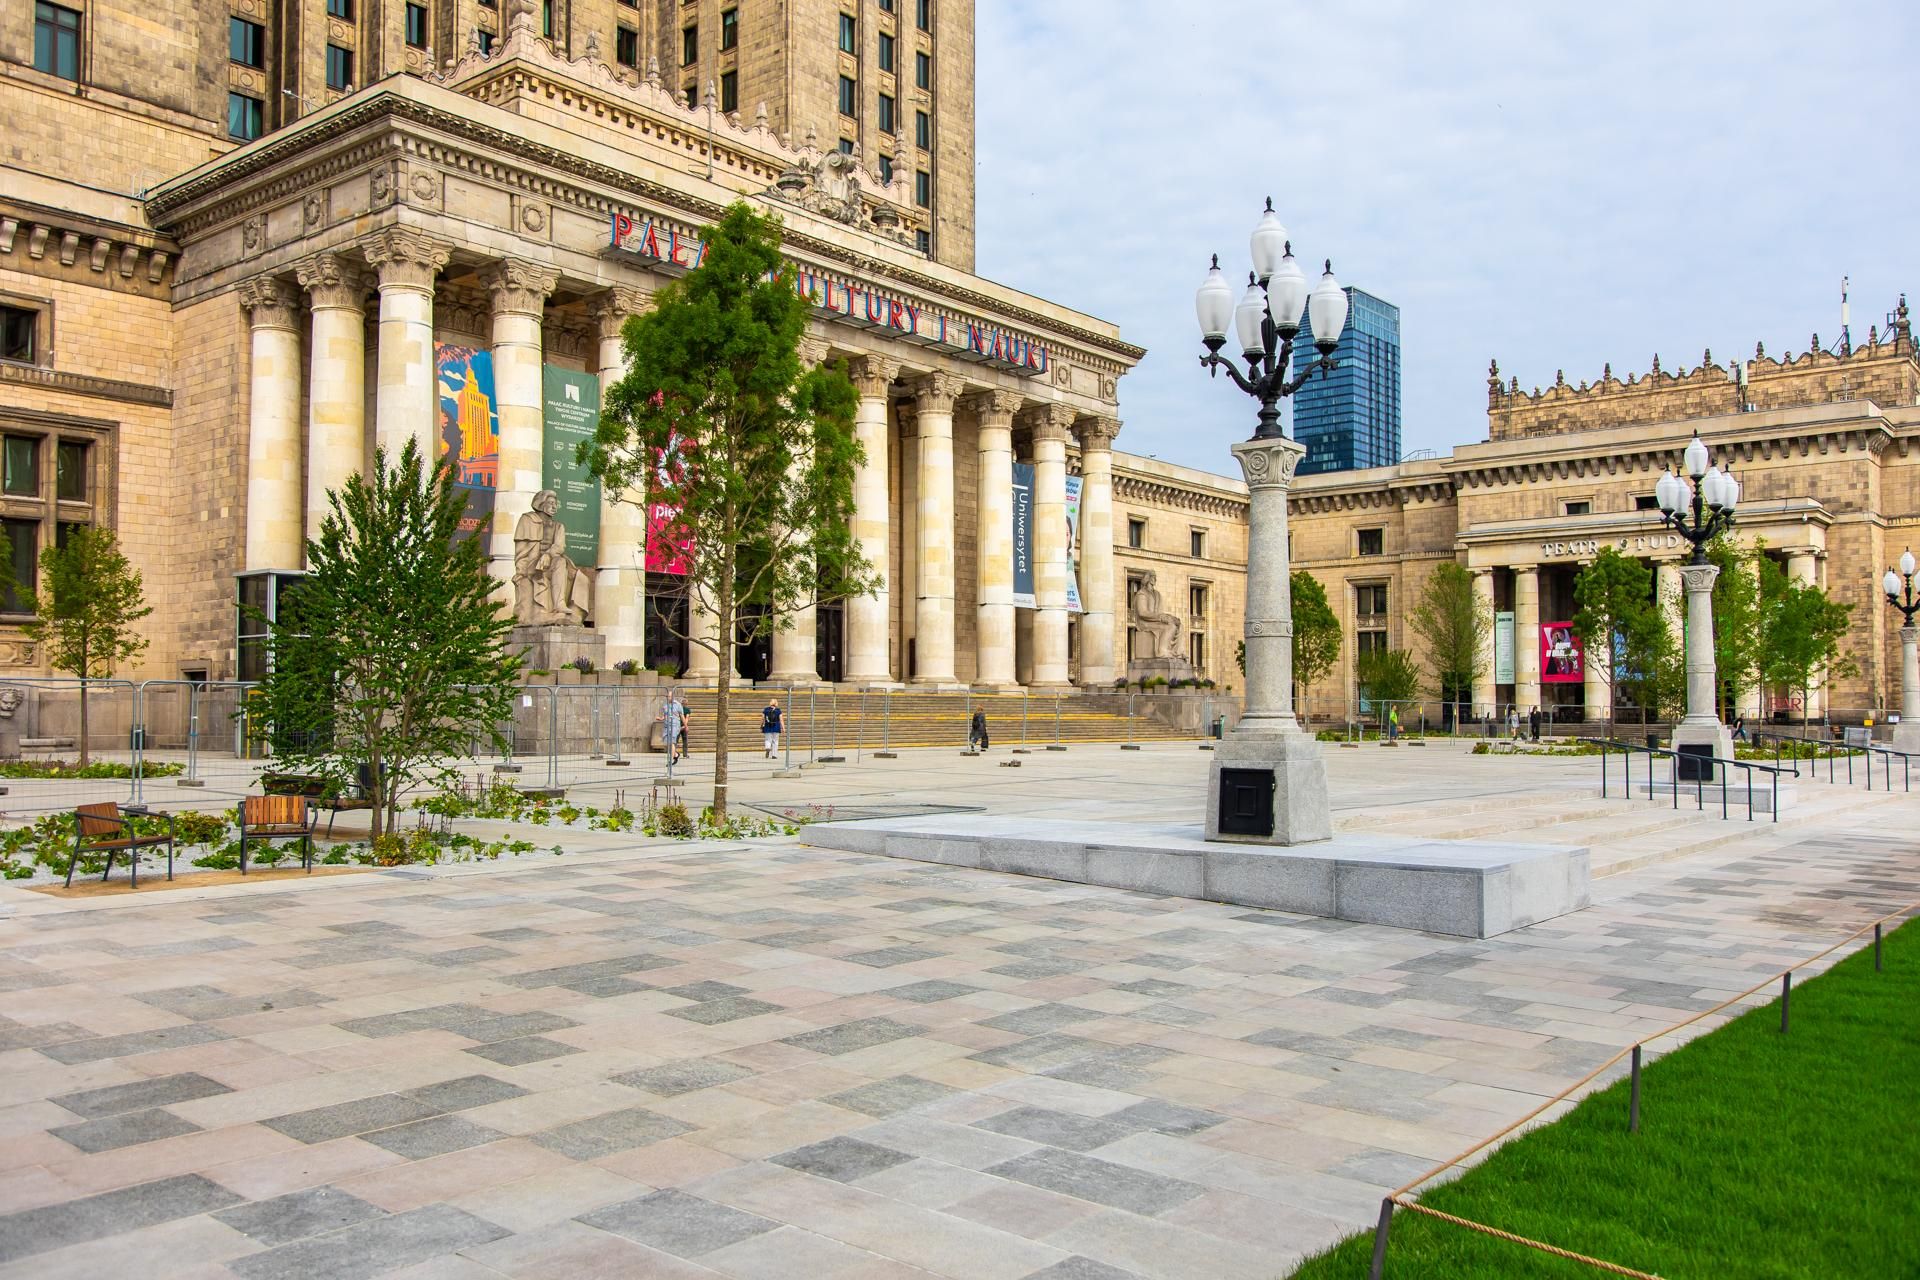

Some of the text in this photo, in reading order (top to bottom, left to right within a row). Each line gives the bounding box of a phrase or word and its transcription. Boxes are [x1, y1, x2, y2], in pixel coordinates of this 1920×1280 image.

[967, 323, 1049, 373] NAUKI
[1016, 492, 1029, 574] Uniwersytet
[1541, 540, 1599, 557] TEATR
